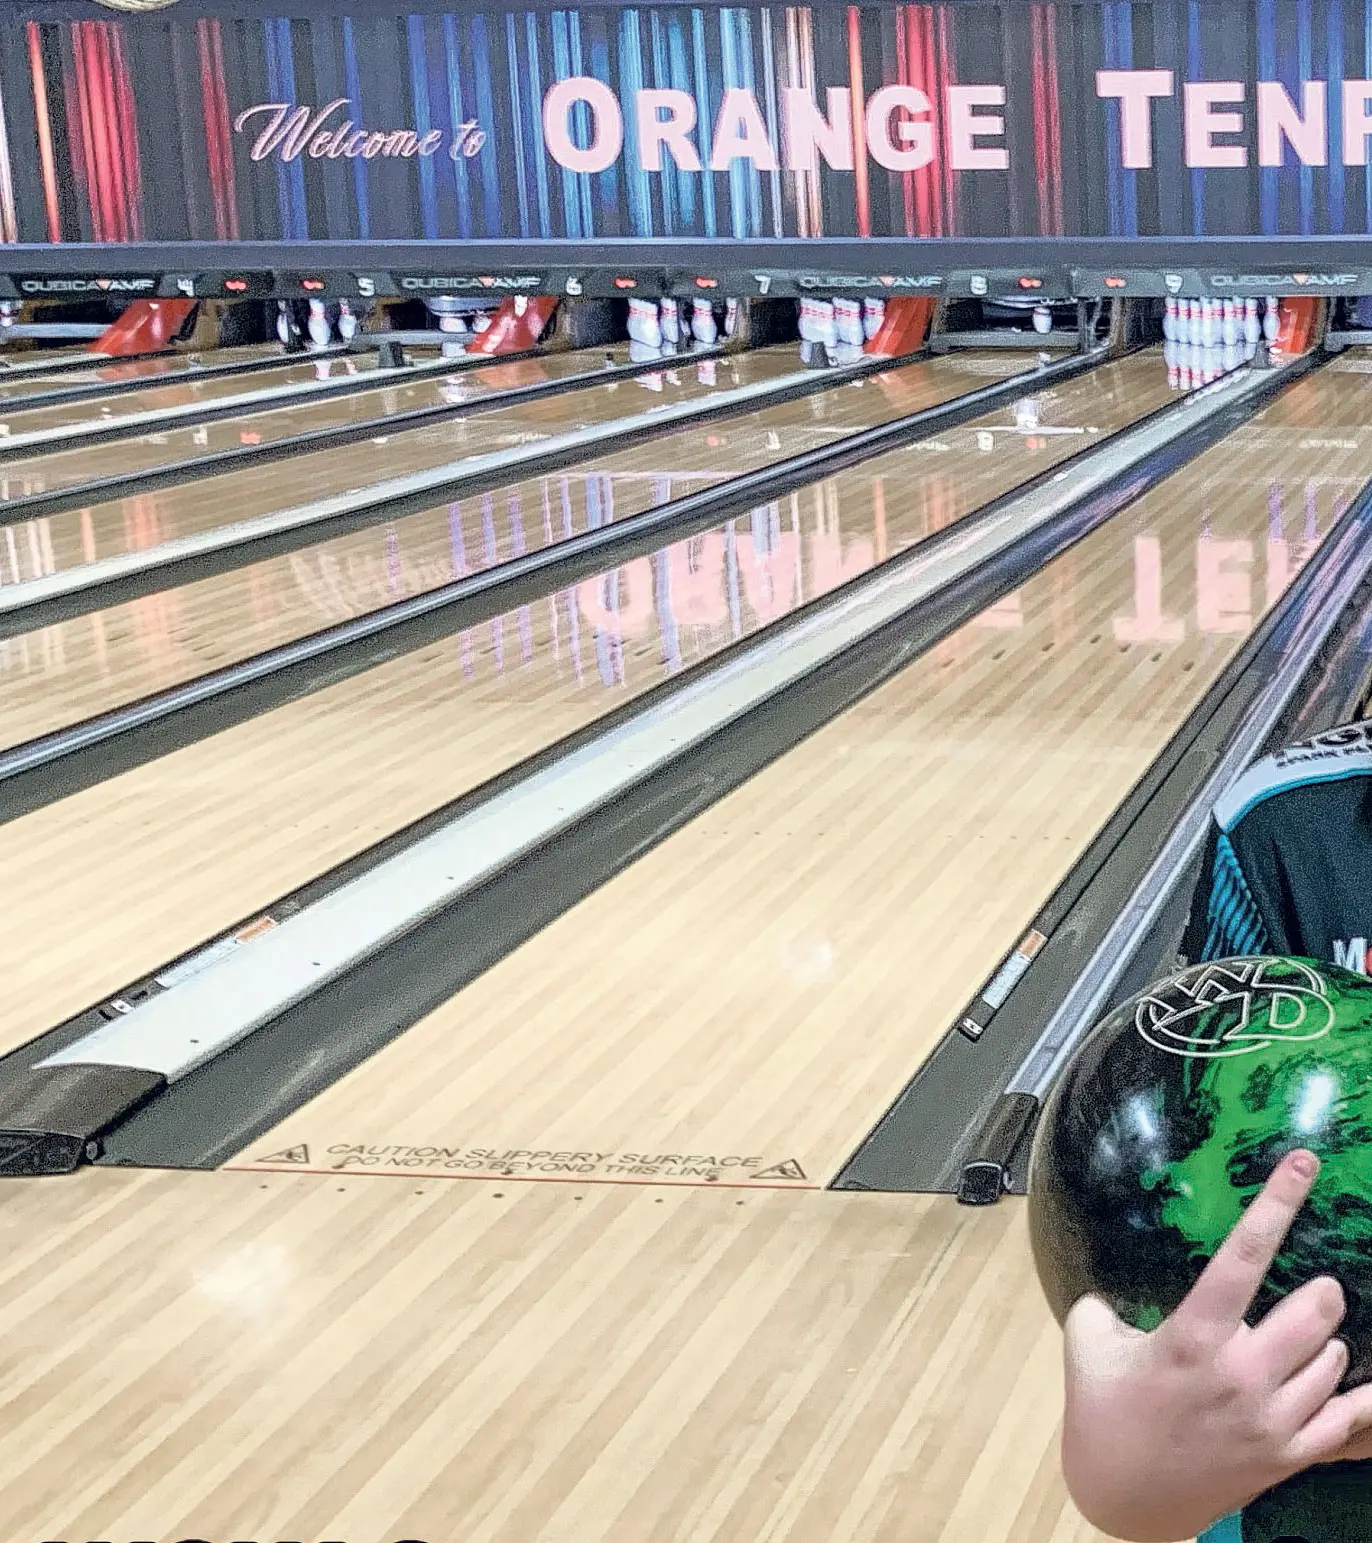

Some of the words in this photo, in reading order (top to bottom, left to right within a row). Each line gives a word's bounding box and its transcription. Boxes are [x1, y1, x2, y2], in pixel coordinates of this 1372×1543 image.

[233, 97, 442, 163] Welcome
[450, 118, 487, 161] to
[542, 76, 1010, 174] ORANGE
[358, 276, 376, 297] 5
[565, 275, 583, 296] 6
[753, 275, 772, 294] 7
[969, 275, 989, 295] 8
[1165, 272, 1184, 294] 9
[326, 1143, 460, 1159] CAUTION
[464, 1147, 614, 1162] SLIPPERY
[617, 1152, 764, 1169] SURFACE
[342, 1155, 381, 1166] DO
[384, 1156, 441, 1168] NOT
[443, 1159, 484, 1170] GO
[487, 1160, 596, 1174] BEYOND
[603, 1163, 660, 1175] THIS
[664, 1165, 724, 1178] LINE
